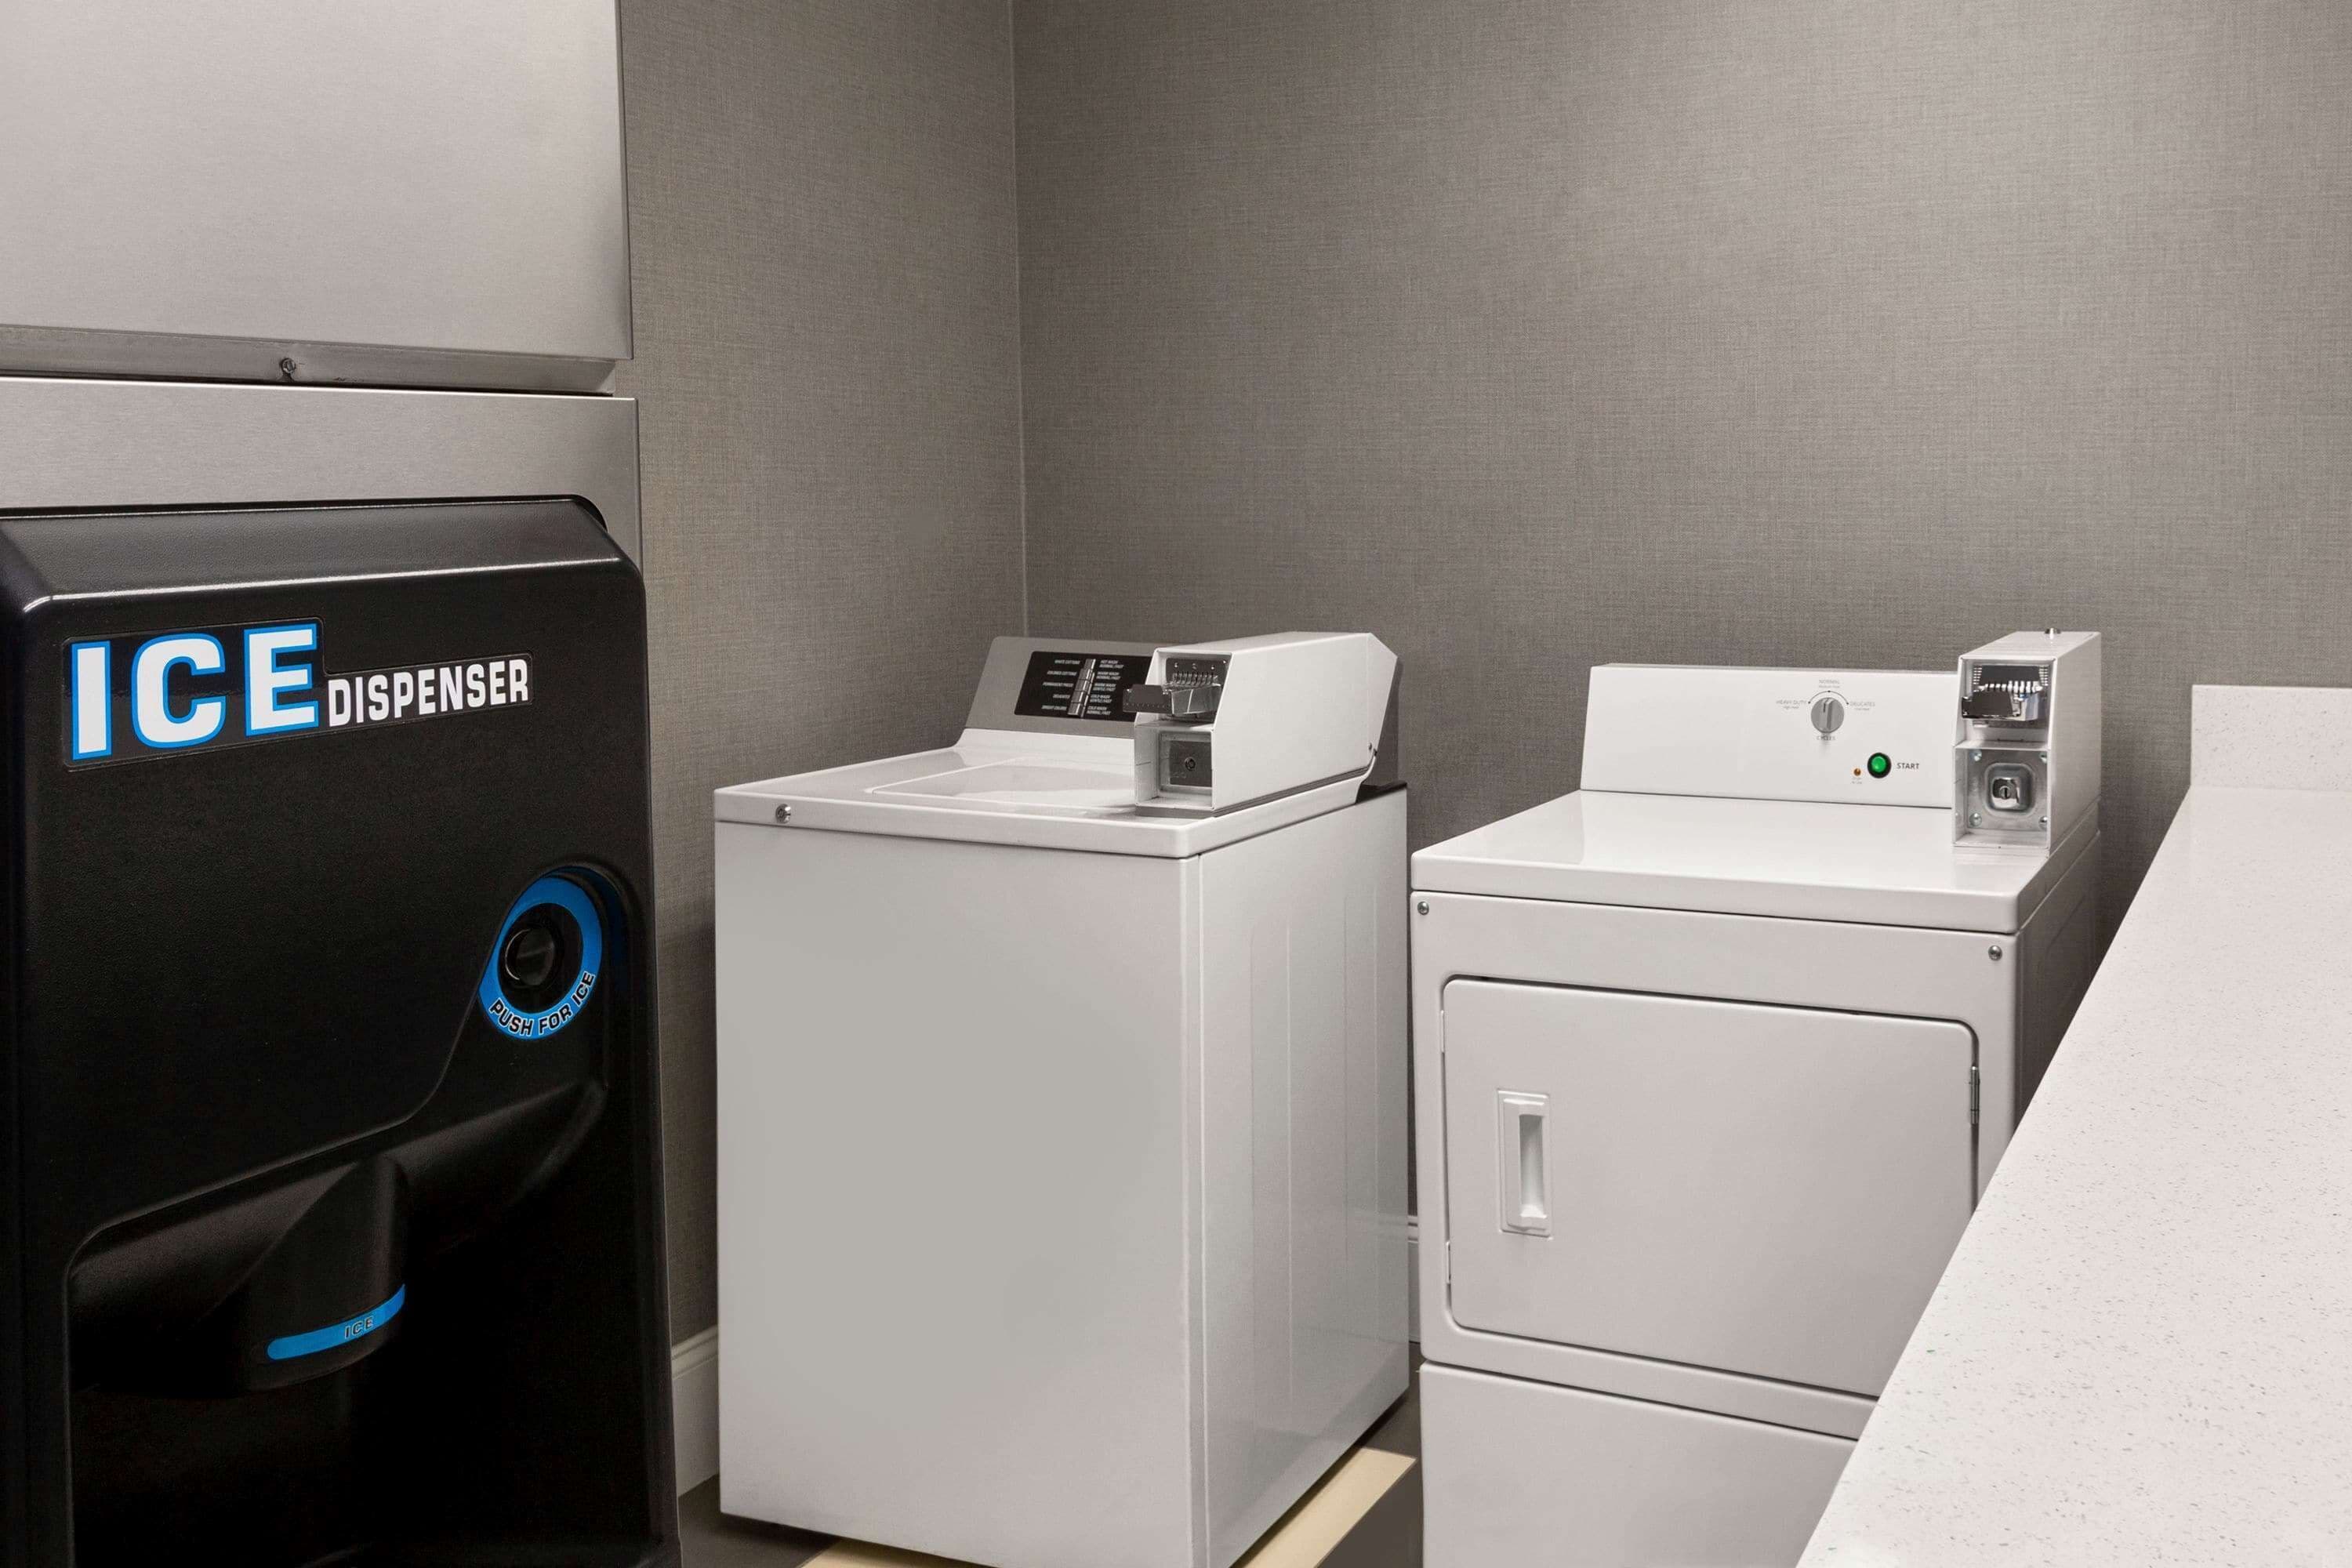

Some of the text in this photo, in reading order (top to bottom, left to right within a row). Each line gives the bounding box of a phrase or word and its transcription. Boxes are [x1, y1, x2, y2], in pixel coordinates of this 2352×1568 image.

[71, 622, 318, 761] ICE
[327, 658, 529, 728] DISPENSER
[489, 970, 596, 1036] PUSH FOR ICE
[343, 1315, 375, 1339] ICE
